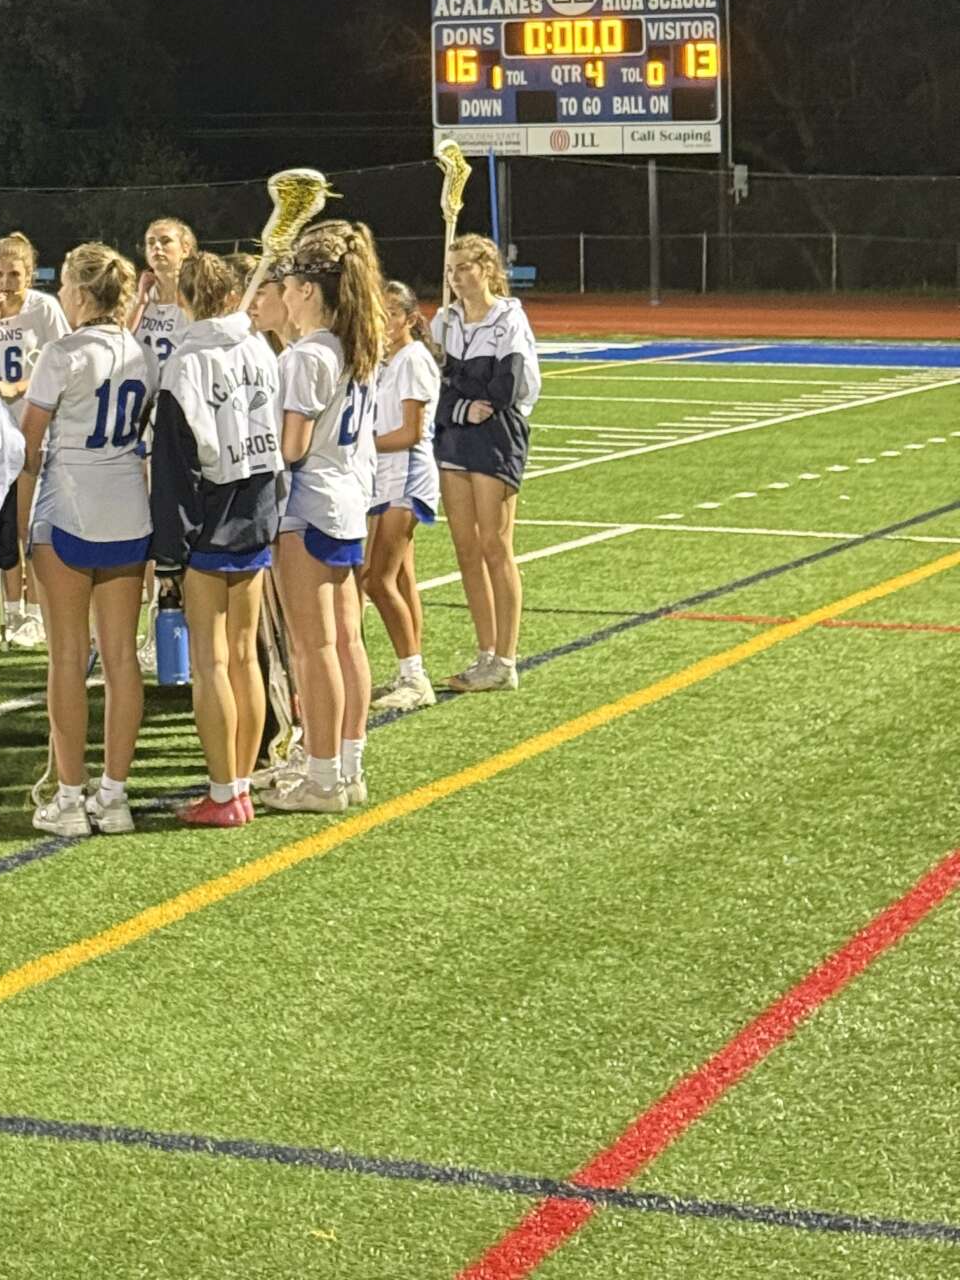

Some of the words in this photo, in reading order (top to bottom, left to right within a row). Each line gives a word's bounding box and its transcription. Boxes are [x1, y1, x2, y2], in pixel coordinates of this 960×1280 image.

[442, 26, 495, 46] DONS
[647, 21, 715, 40] VISITOR
[446, 48, 478, 83] 16
[685, 43, 717, 78] 13
[492, 65, 503, 90] 1
[506, 70, 528, 85] TOL
[551, 64, 581, 86] QTR
[585, 60, 605, 88] 4
[621, 67, 643, 83] TOL
[646, 61, 665, 87] 0
[461, 98, 502, 117] DOWN
[560, 97, 578, 116] TO
[582, 96, 601, 115] GO
[612, 96, 646, 114] BALL
[650, 95, 669, 114] ON
[571, 132, 599, 148] JLL
[85, 378, 147, 449] 10
